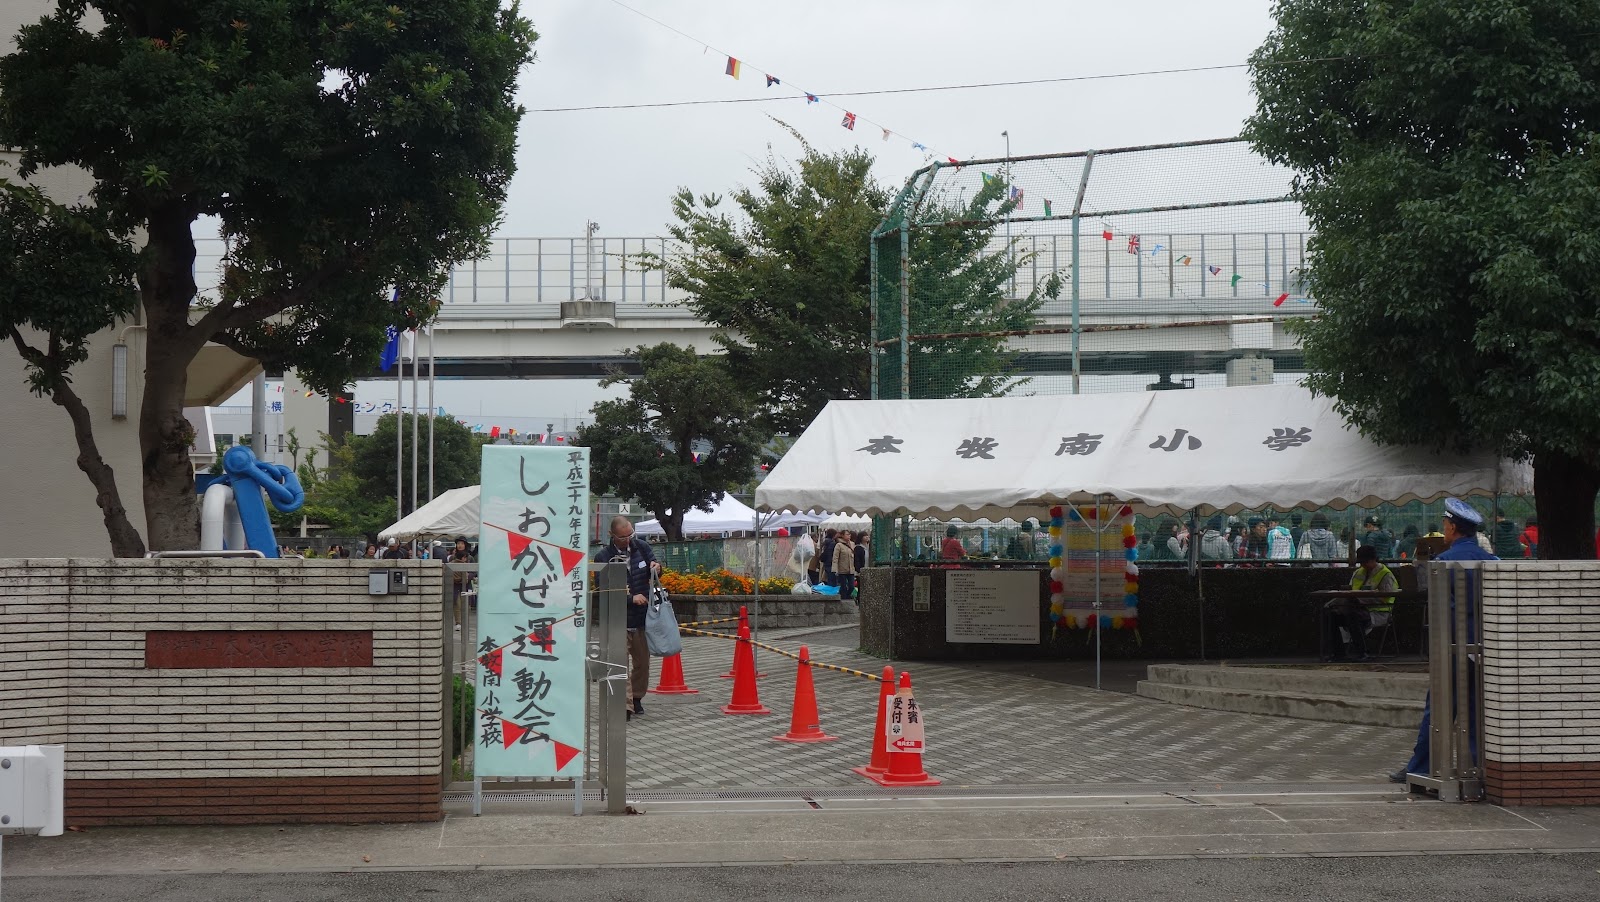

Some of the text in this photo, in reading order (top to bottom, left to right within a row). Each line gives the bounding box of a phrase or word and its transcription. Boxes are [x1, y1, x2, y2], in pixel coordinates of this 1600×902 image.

[567, 451, 587, 628] 平成二十九年度 第四十七回
[620, 504, 629, 513] 入
[511, 455, 560, 745] しおかぜ運動会
[477, 635, 504, 749] 本牧南小学校
[891, 696, 903, 724] 受付
[907, 697, 919, 724] 来賓
